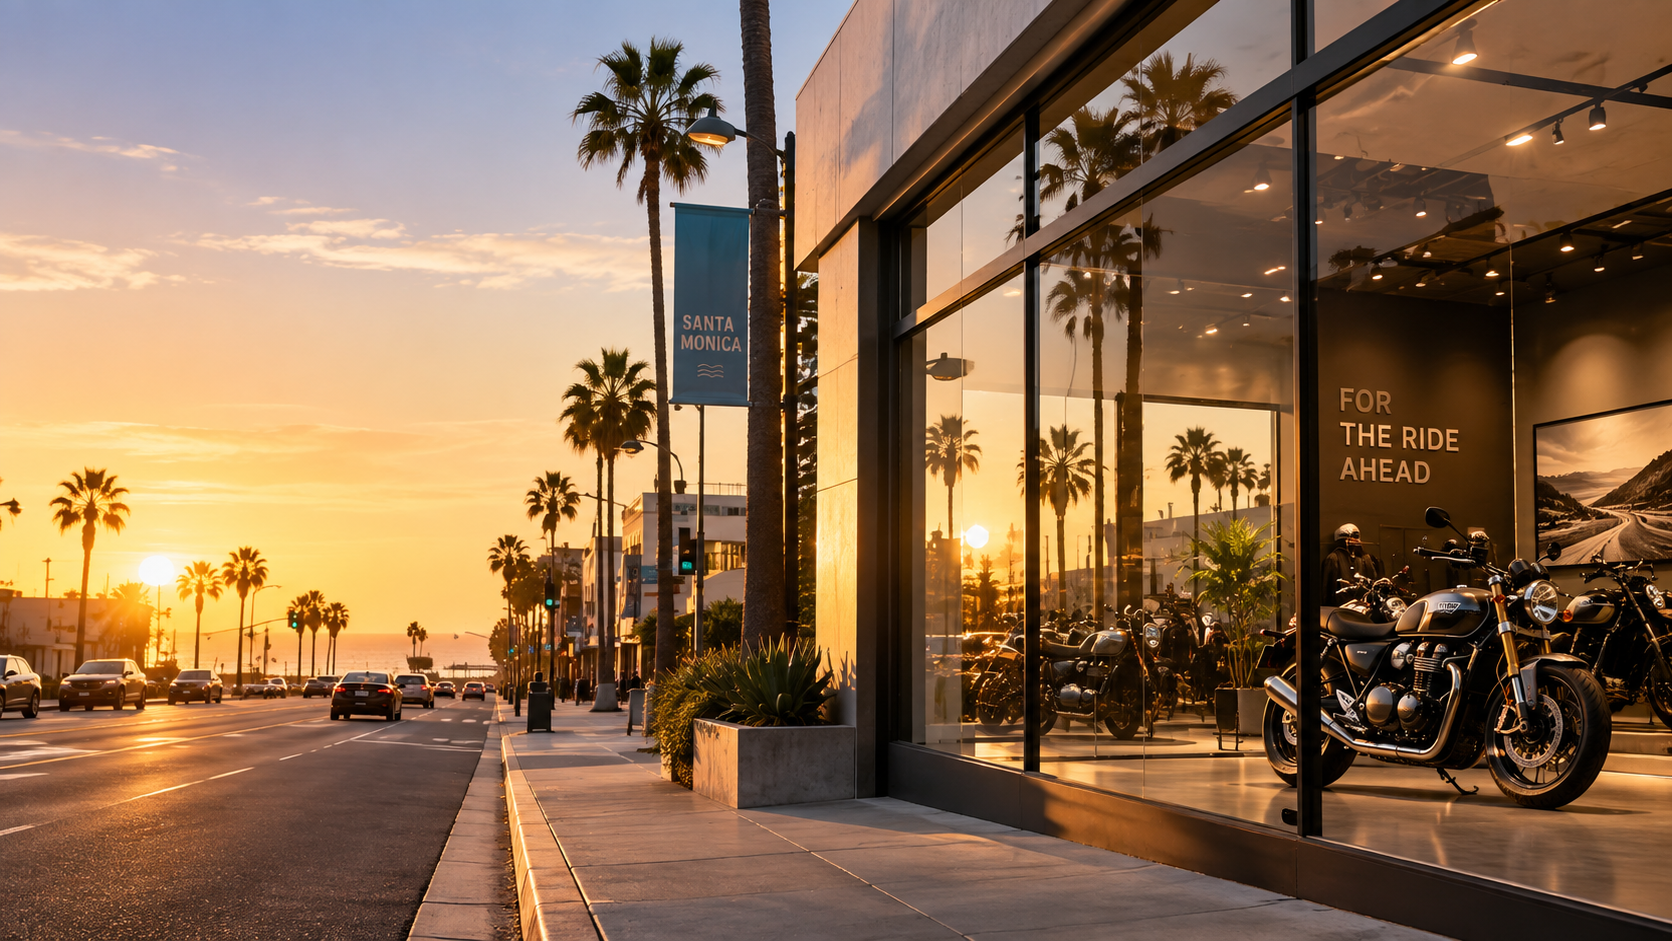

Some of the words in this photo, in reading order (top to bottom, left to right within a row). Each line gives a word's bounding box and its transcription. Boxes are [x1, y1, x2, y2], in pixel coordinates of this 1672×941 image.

[682, 314, 734, 333] SANTA
[680, 334, 742, 353] MONICA
[1340, 387, 1392, 415] FOR
[1339, 421, 1392, 448] THE
[1402, 425, 1460, 452] RIDE
[1339, 456, 1431, 484] AHEAD
